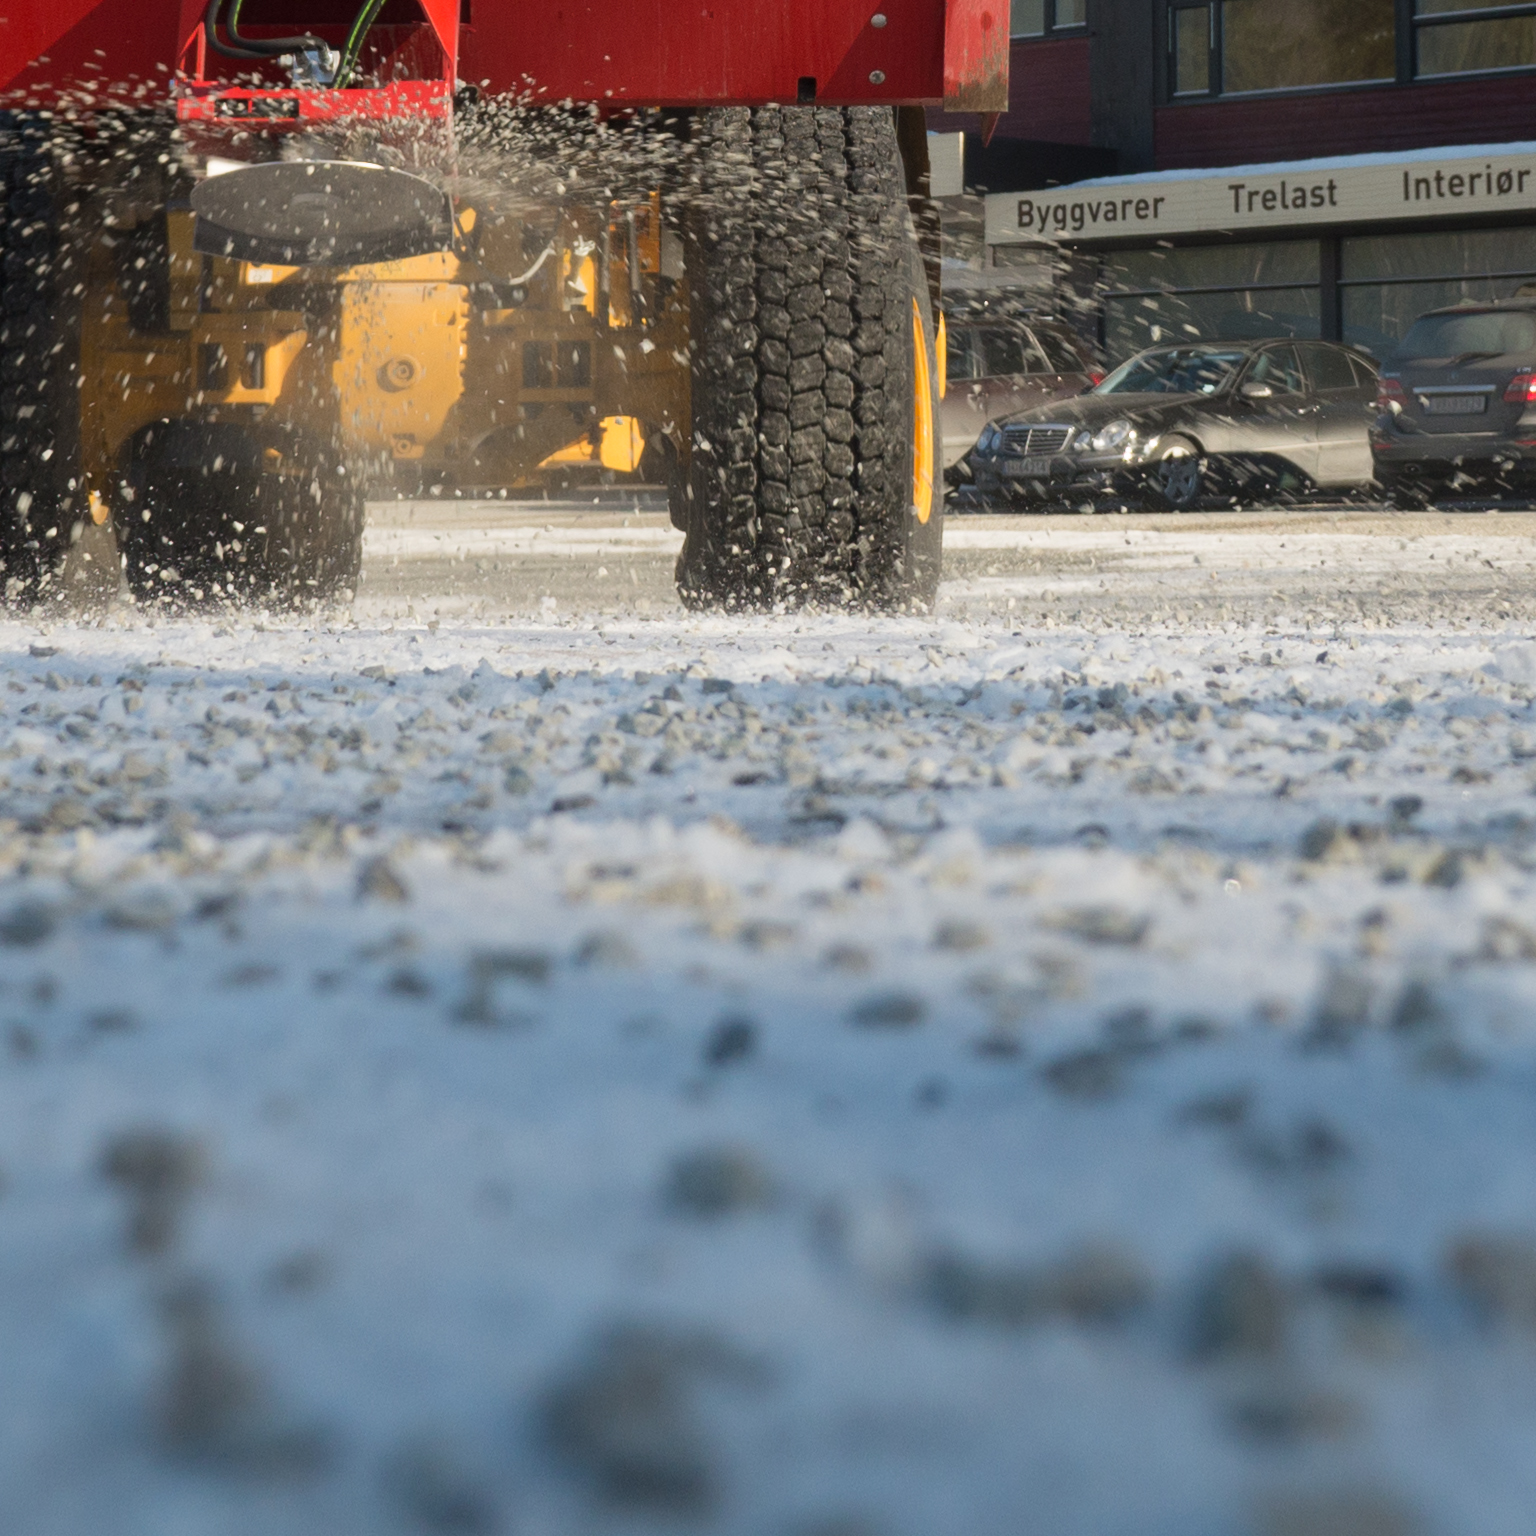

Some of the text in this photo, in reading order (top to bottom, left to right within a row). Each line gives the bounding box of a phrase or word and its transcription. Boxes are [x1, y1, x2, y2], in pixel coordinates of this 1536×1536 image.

[1227, 178, 1338, 214] Trelast
[1402, 168, 1532, 202] Interiør
[1017, 196, 1166, 234] Byggvarer
